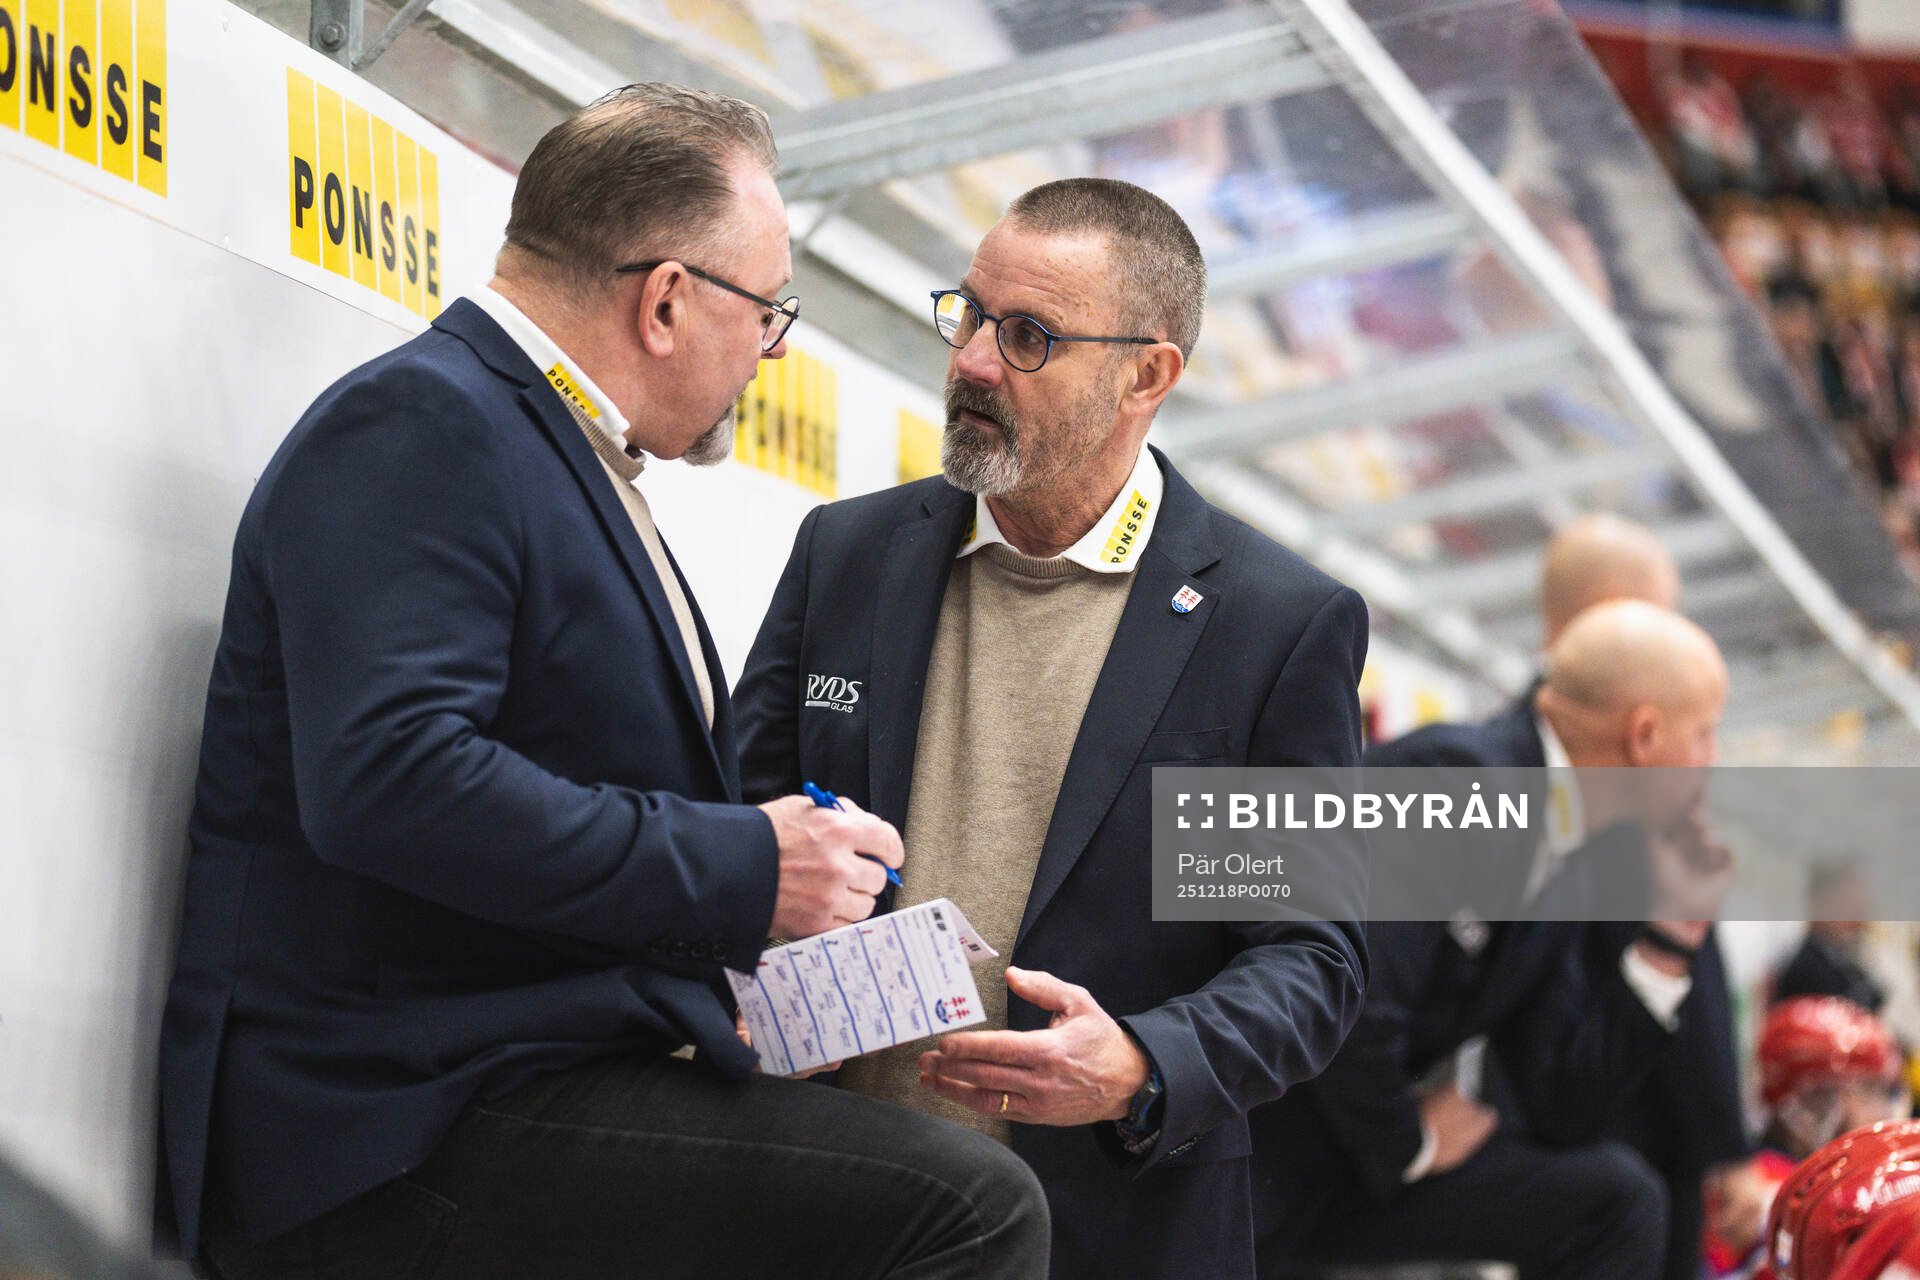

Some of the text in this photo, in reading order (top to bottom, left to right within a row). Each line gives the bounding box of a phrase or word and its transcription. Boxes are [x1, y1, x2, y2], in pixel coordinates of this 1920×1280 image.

[294, 156, 438, 297] PONSSE
[1111, 498, 1147, 563] PONSSE
[806, 674, 863, 704] RYDS
[830, 702, 854, 713] GLAS
